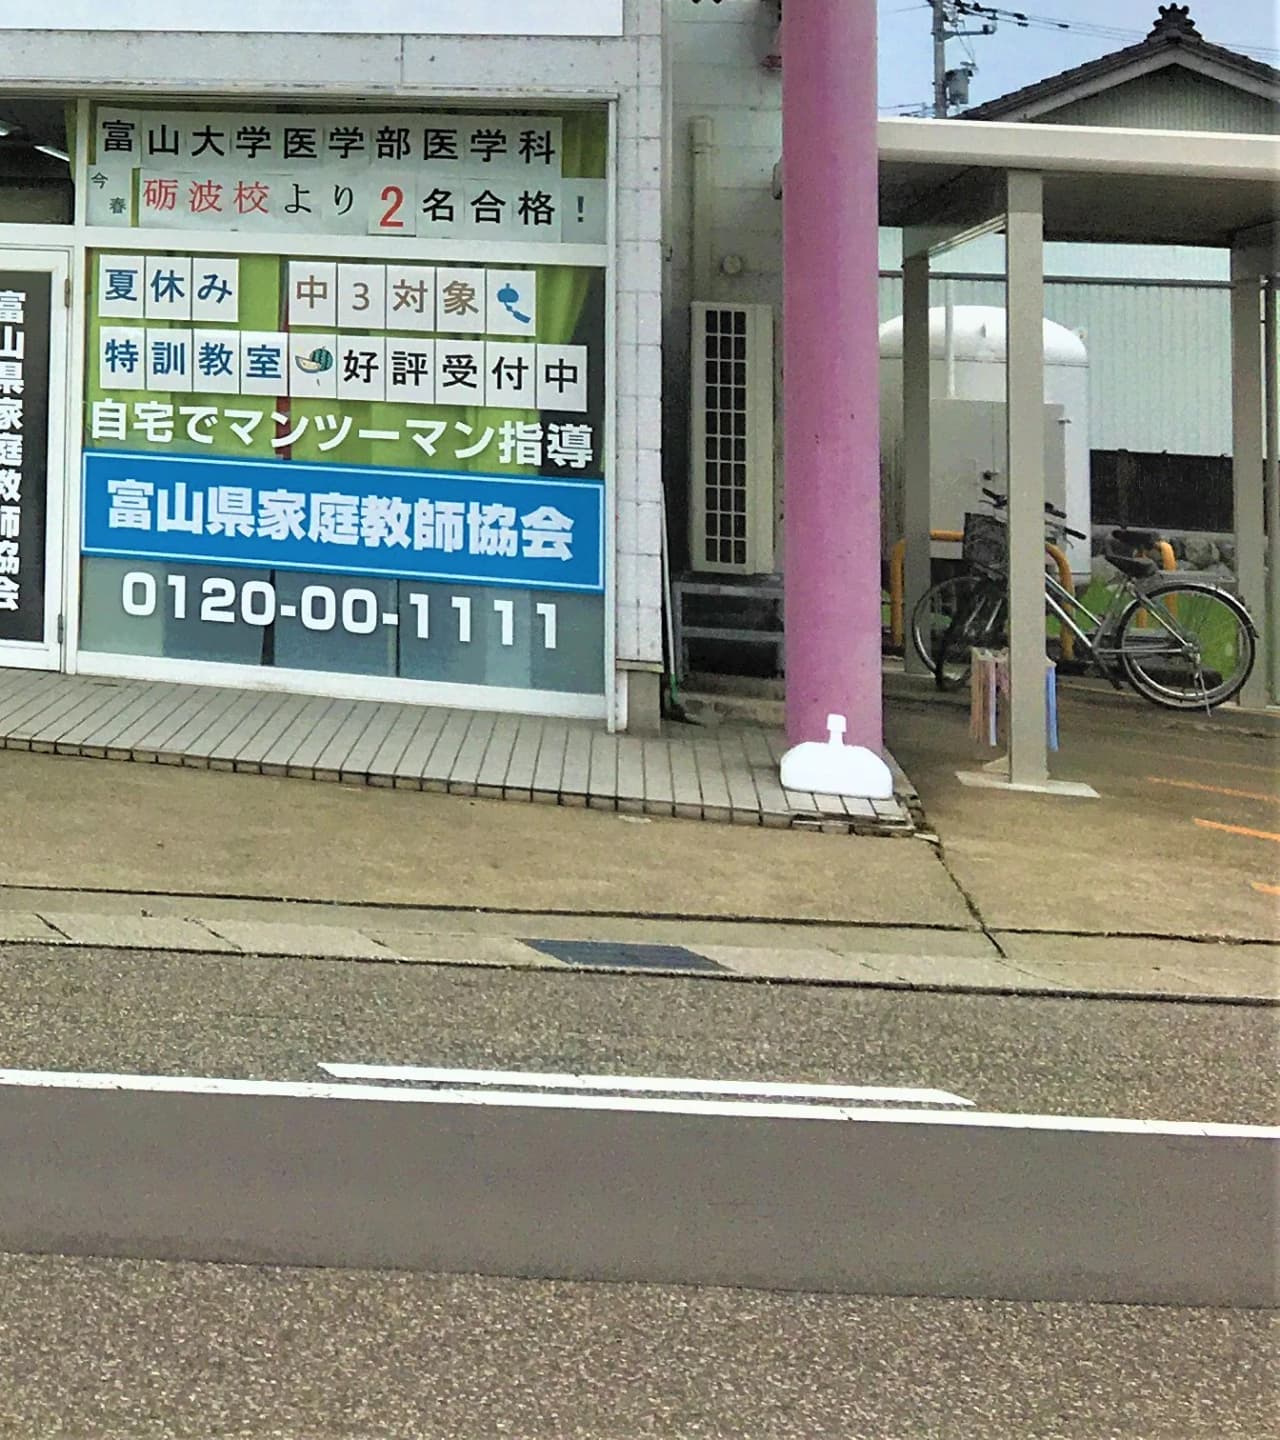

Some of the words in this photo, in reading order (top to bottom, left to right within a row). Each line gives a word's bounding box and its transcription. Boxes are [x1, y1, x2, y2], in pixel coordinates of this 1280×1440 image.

[101, 120, 557, 165] 富山大学医学部医学科
[105, 267, 233, 304] 夏休み
[295, 274, 480, 317] 中3対象
[104, 338, 282, 380] 特訓教室
[342, 348, 580, 395] 好評受付中
[90, 399, 594, 470] 自宅でマンツーマン指導
[107, 479, 575, 562] 富山県家庭教師協会
[121, 571, 559, 650] 0120-00-1111
